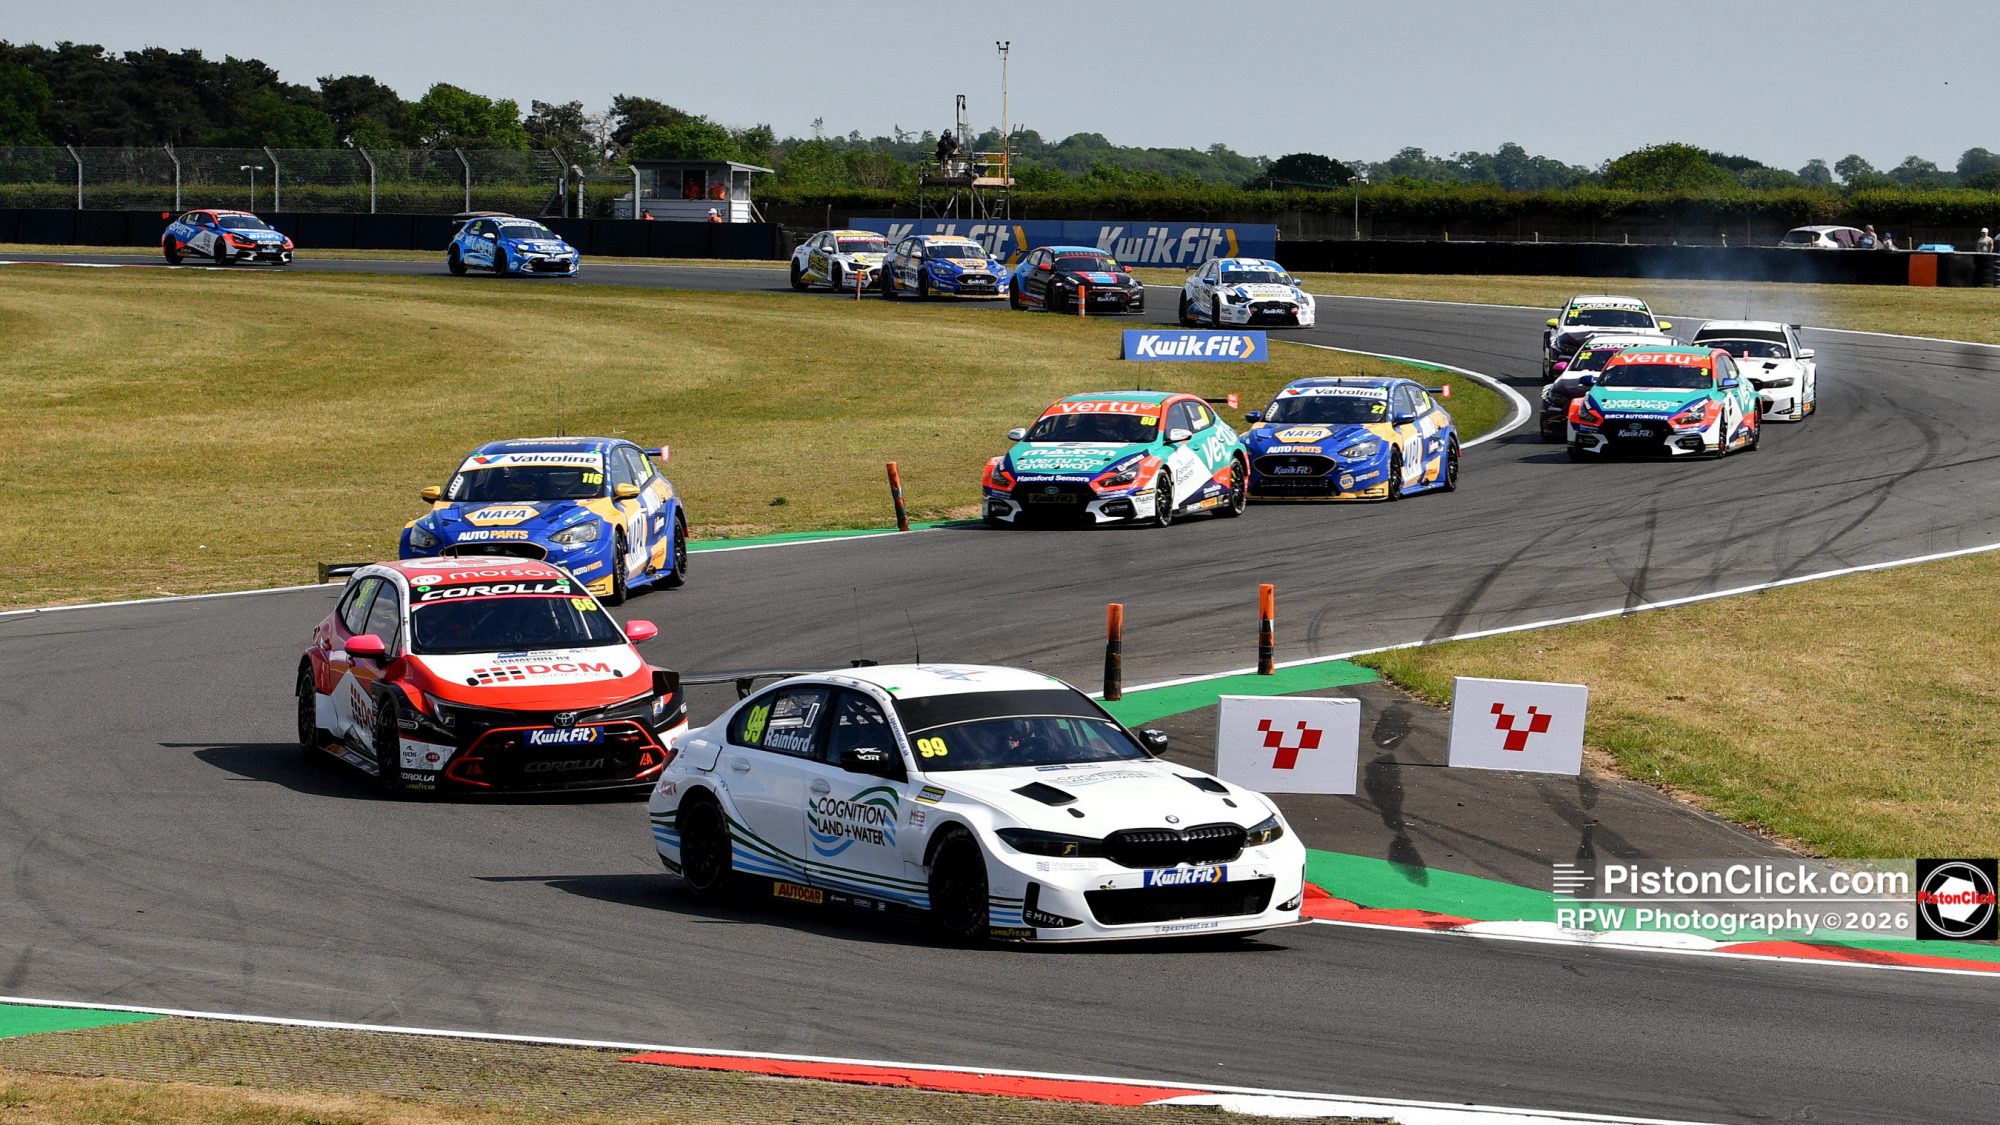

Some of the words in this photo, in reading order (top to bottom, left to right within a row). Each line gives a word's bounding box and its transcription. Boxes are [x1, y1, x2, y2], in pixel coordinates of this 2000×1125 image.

[1096, 226, 1223, 264] KwikFit
[1136, 335, 1242, 357] KwikFit
[1620, 353, 1691, 364] vertu
[1700, 368, 1708, 376] 3
[1314, 388, 1382, 397] Valvoline
[1060, 401, 1138, 413] vertu
[1371, 405, 1387, 414] 27
[1140, 416, 1158, 426] 80
[510, 454, 597, 464] Valvoline
[582, 472, 603, 484] 116
[476, 509, 527, 519] NAPA
[458, 530, 489, 541] AUTO
[490, 530, 529, 539] PARTS
[421, 584, 571, 601] COROLLA
[571, 598, 598, 611] 66
[525, 662, 612, 674] DCM
[743, 705, 770, 743] 99
[530, 728, 592, 745] KwikFit
[763, 728, 812, 753] Rainford
[916, 736, 949, 758] 99
[818, 796, 887, 827] COGNITION
[1149, 865, 1215, 887] KwikFit
[778, 883, 822, 904] AUTOCAR
